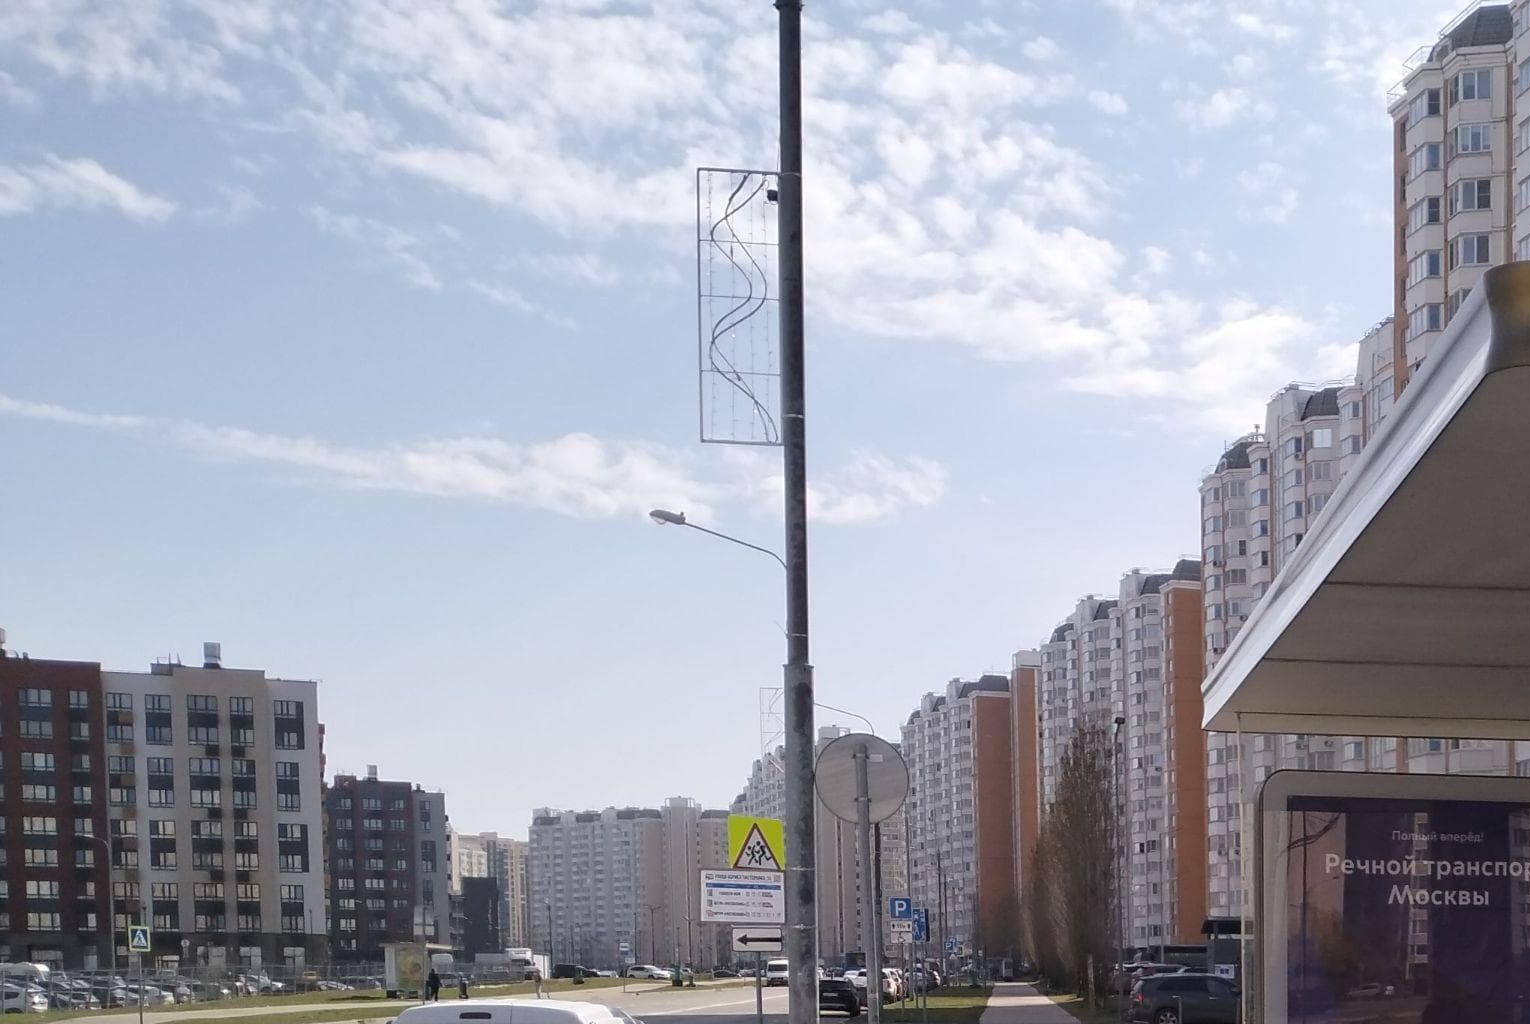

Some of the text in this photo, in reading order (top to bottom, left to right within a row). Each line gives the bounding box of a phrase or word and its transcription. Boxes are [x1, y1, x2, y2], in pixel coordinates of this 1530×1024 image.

[1391, 830, 1485, 843] Полный вперёд!
[1324, 853, 1416, 876] Речной
[1388, 884, 1490, 906] Москвы
